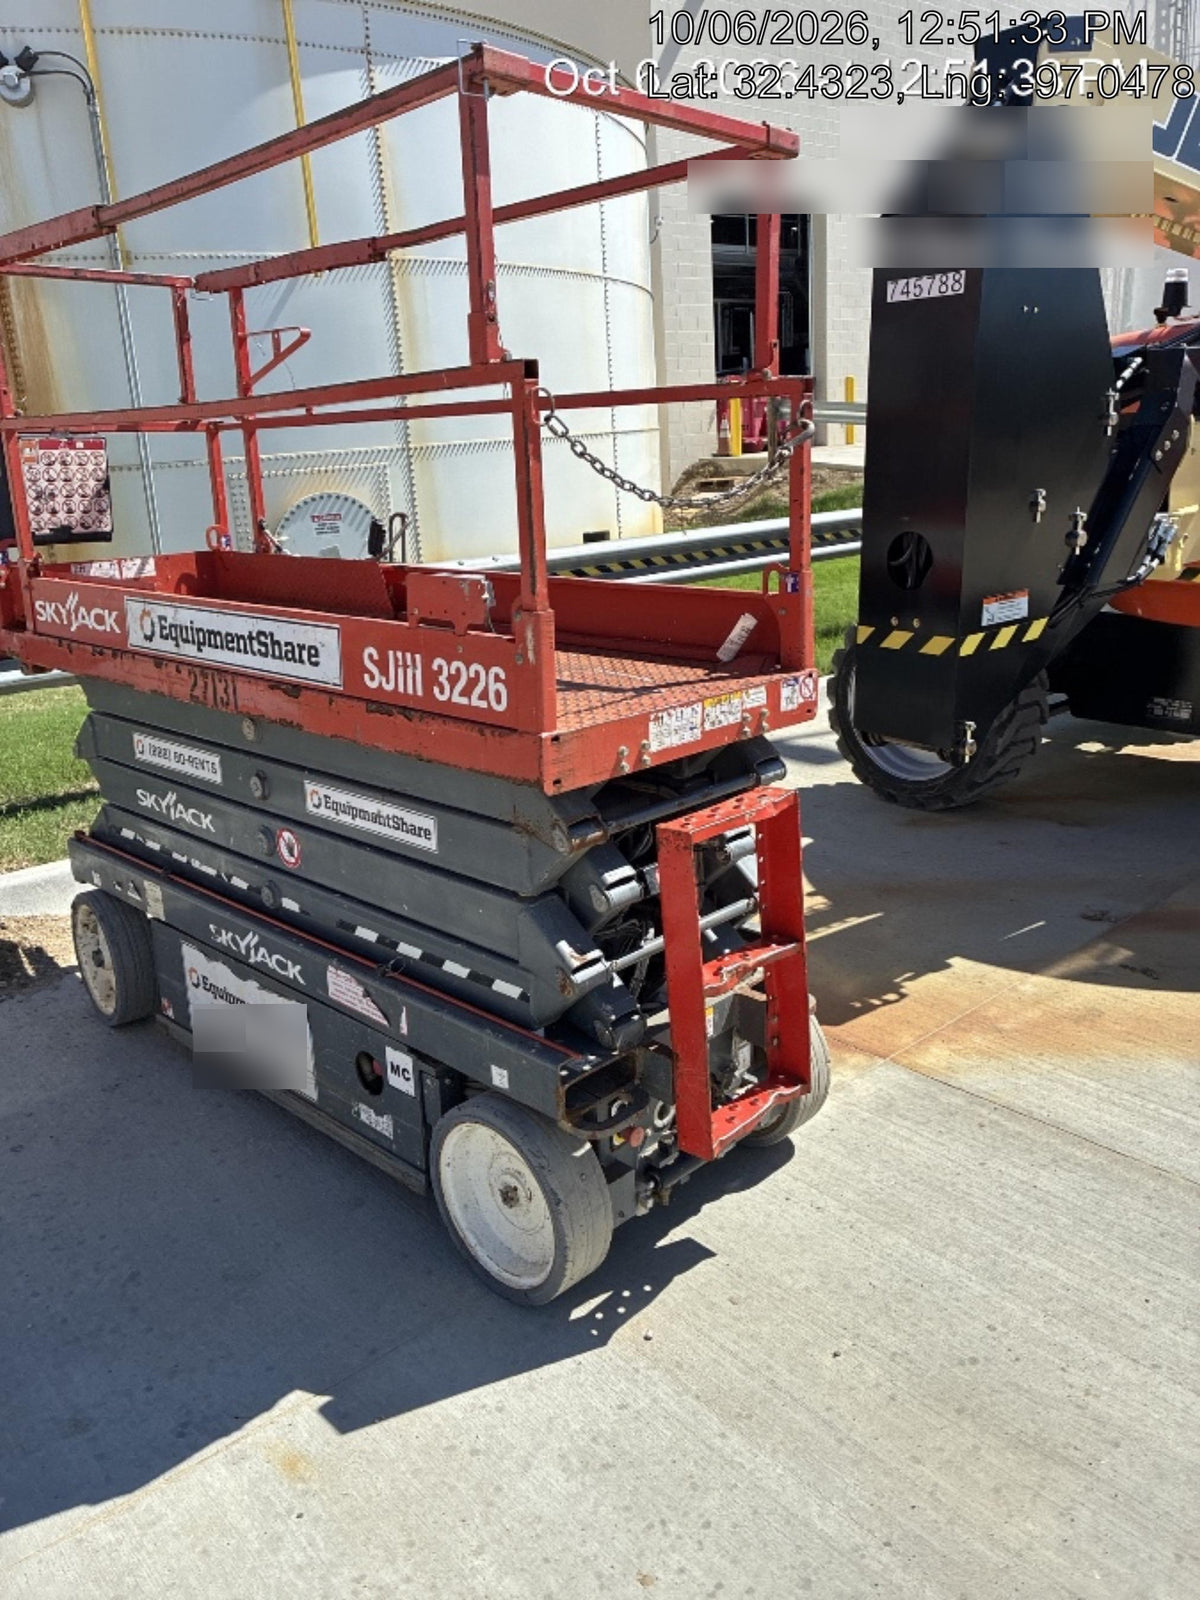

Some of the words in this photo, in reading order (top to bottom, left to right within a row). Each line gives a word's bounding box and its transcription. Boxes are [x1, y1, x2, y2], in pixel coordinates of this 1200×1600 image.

[888, 272, 963, 301] 745788
[35, 592, 121, 634] SKYJACK
[158, 615, 321, 668] EquipmentShare
[431, 657, 508, 712] 3226
[136, 789, 216, 832] SKYJACK
[390, 1061, 411, 1081] MC
